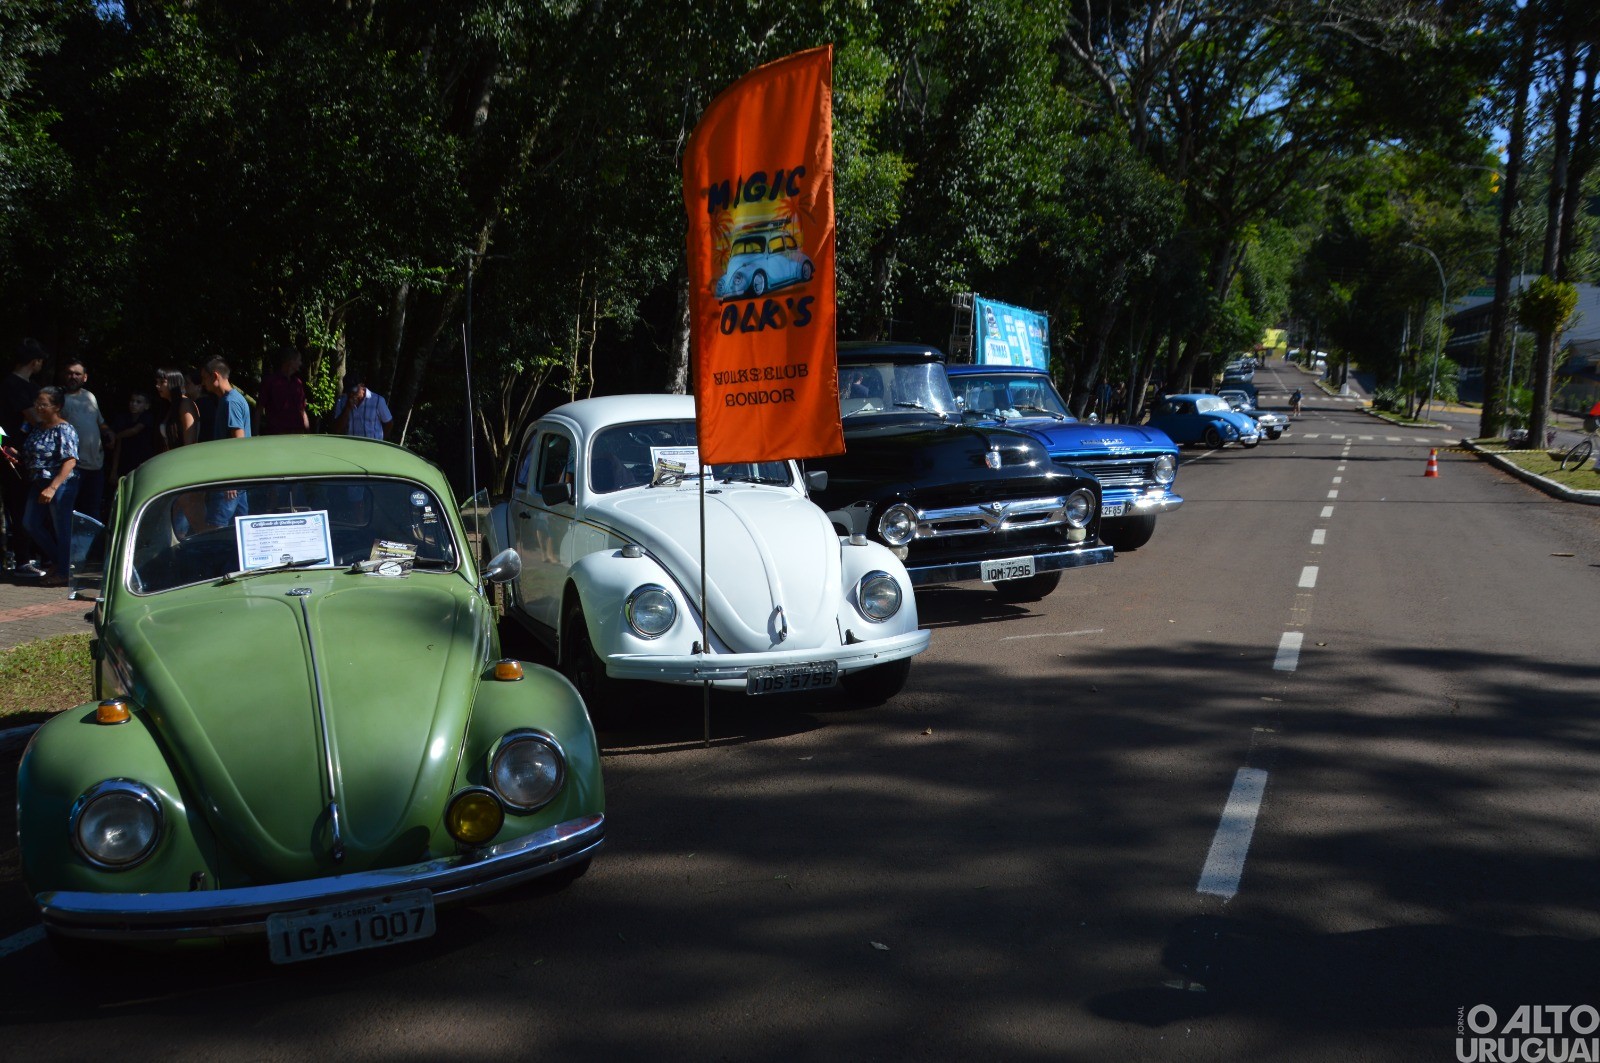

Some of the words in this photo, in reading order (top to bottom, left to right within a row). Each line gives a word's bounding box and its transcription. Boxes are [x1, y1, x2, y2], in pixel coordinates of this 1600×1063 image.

[720, 296, 815, 335] OLK'S
[763, 364, 809, 381] CLUB
[725, 388, 796, 407] CONDOR
